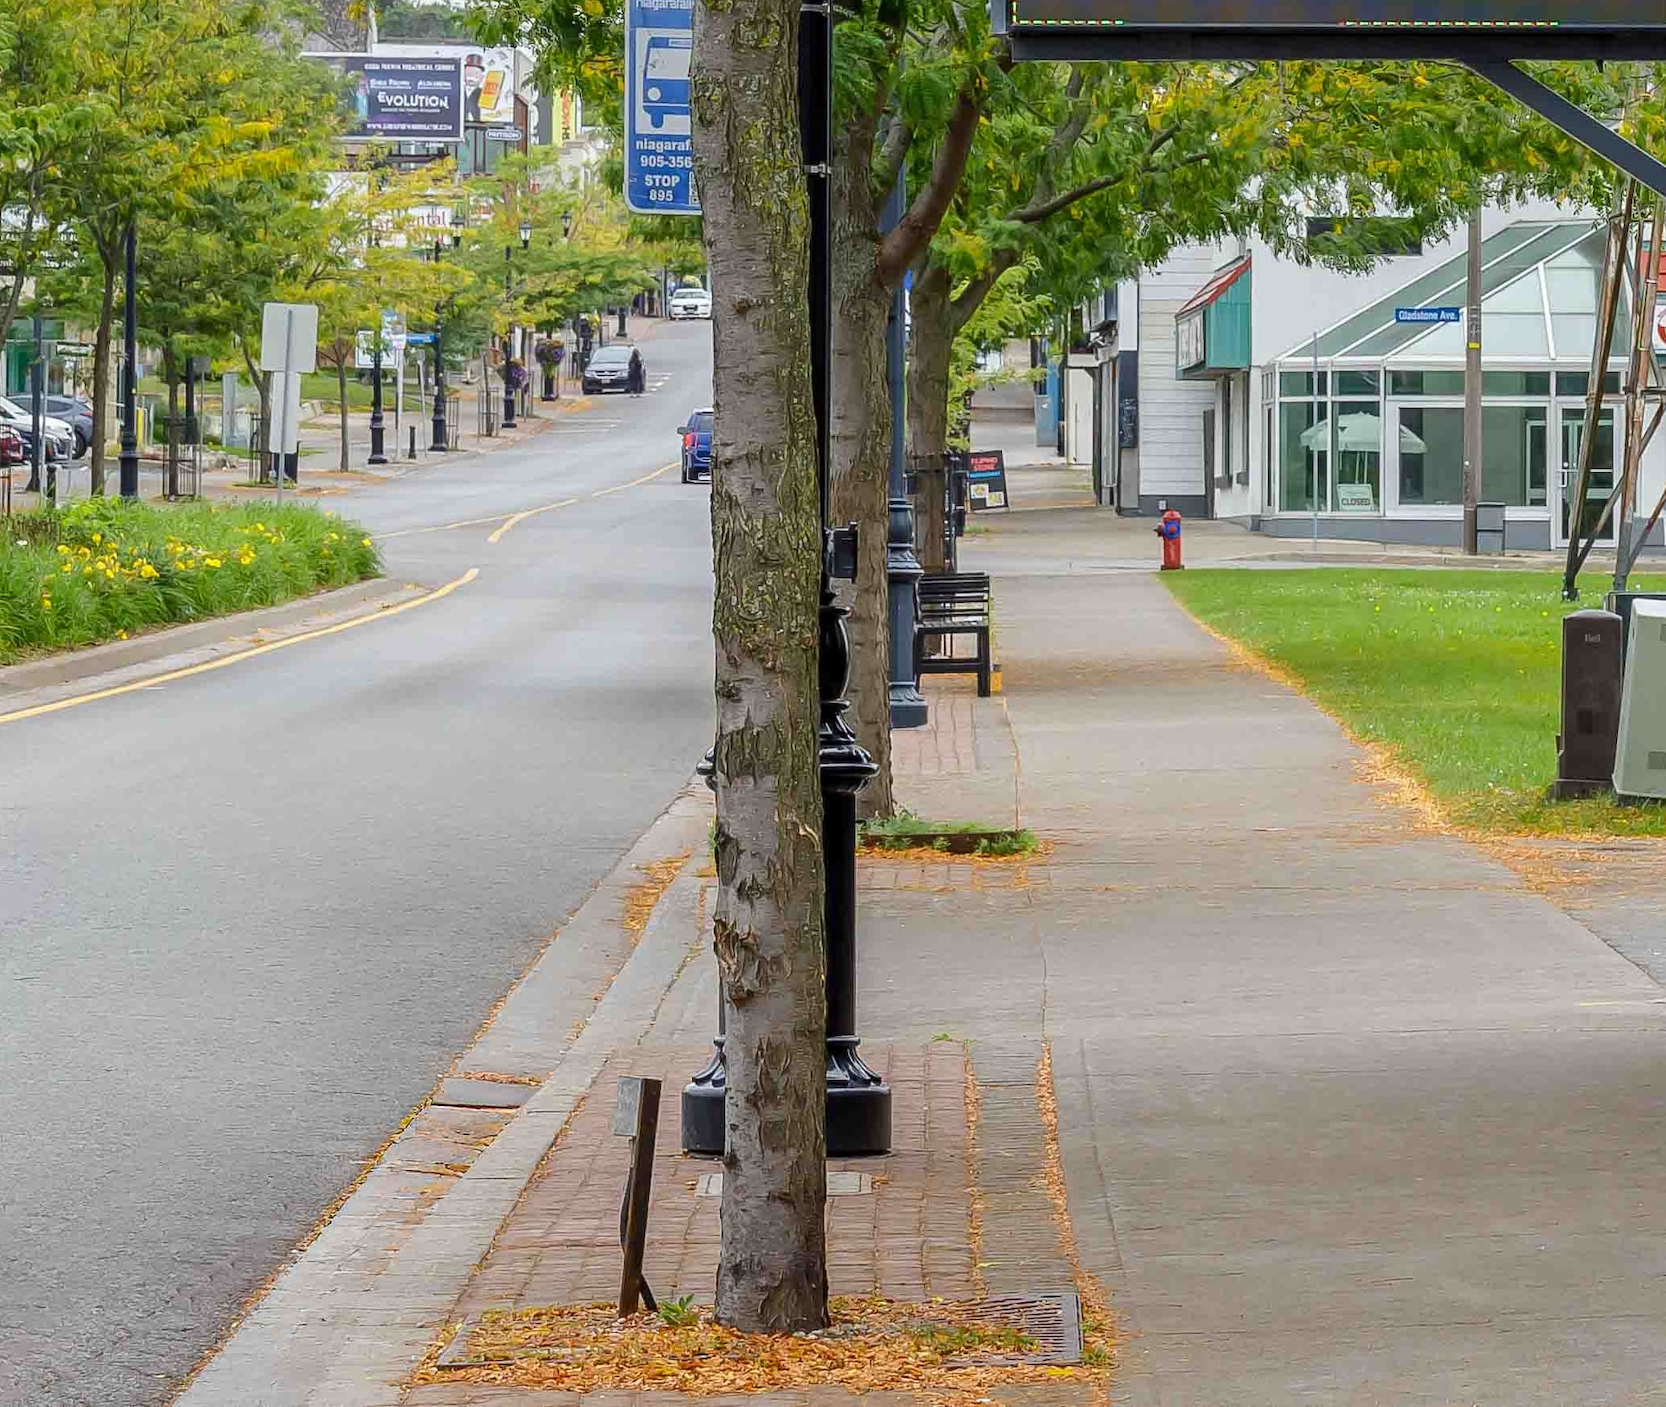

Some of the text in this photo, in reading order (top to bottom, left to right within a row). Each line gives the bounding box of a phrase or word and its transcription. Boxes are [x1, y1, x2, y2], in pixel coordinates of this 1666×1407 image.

[635, 138, 693, 153] niagaraf
[644, 174, 681, 188] STOP
[649, 188, 674, 202] 895
[1398, 310, 1439, 321] Gladstone
